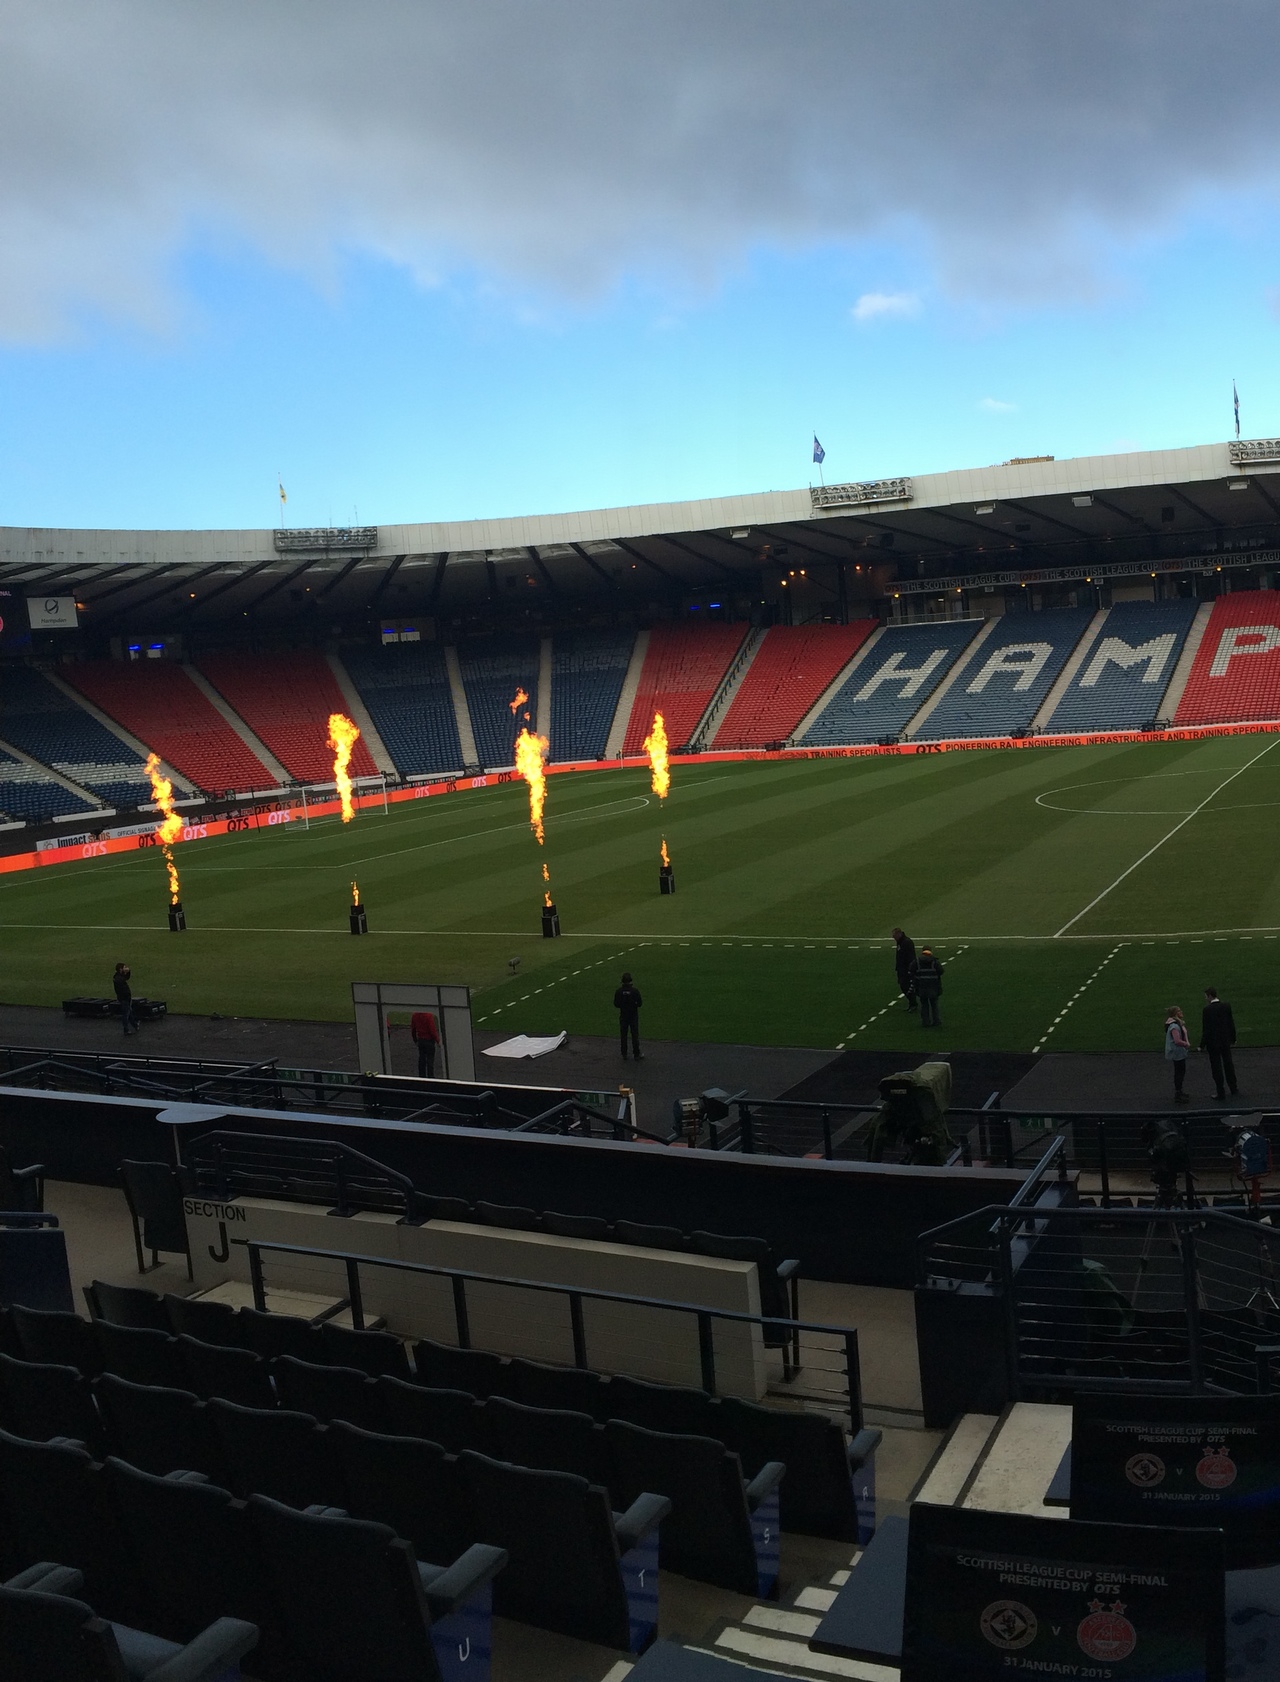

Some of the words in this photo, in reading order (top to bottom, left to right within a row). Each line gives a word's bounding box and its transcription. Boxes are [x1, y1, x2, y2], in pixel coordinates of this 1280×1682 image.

[964, 575, 998, 587] LEAGUE
[999, 573, 1016, 583] CUP
[1045, 571, 1063, 580] THE
[1064, 565, 1103, 578] SCOTTISH
[1106, 562, 1141, 575] LEAGUE
[1141, 561, 1158, 571] CUP
[1187, 559, 1206, 568] THE
[1207, 553, 1248, 567] SCOTTISH
[946, 742, 997, 751] PIONEERING
[1000, 740, 1018, 749] RAIL
[1086, 733, 1165, 746] INFRASTRUCTURE
[1168, 731, 1186, 741] AND
[1188, 728, 1230, 740] TRAINING
[810, 749, 848, 759] TRAINING
[850, 747, 902, 758] SPECIALISTS
[184, 1200, 247, 1222] SECTION
[208, 1221, 230, 1264] J
[1106, 1424, 1148, 1434] SCOTTISH
[1150, 1426, 1186, 1436] LEAGUE
[1186, 1427, 1206, 1436] CUP
[1207, 1427, 1259, 1436] SEMI-FINAL
[1138, 1434, 1190, 1444] PRESENTED
[1190, 1435, 1201, 1444] BY
[1142, 1492, 1153, 1500] 31
[1154, 1492, 1196, 1501] JANUARY
[1200, 1493, 1221, 1501] 2015
[764, 1527, 770, 1544] S
[638, 1569, 645, 1588] T
[957, 1554, 1014, 1573] SCOTTISH
[1016, 1563, 1066, 1578] LEAGUE
[1066, 1568, 1093, 1580] CUP
[1095, 1572, 1168, 1587] SEMI-FINAL
[999, 1573, 1070, 1591] PRESENTED
[1072, 1581, 1089, 1592] BY
[458, 1637, 470, 1662] U
[1003, 1656, 1019, 1667] 31
[1019, 1658, 1078, 1676] JANUARY
[1081, 1666, 1112, 1679] 2015
